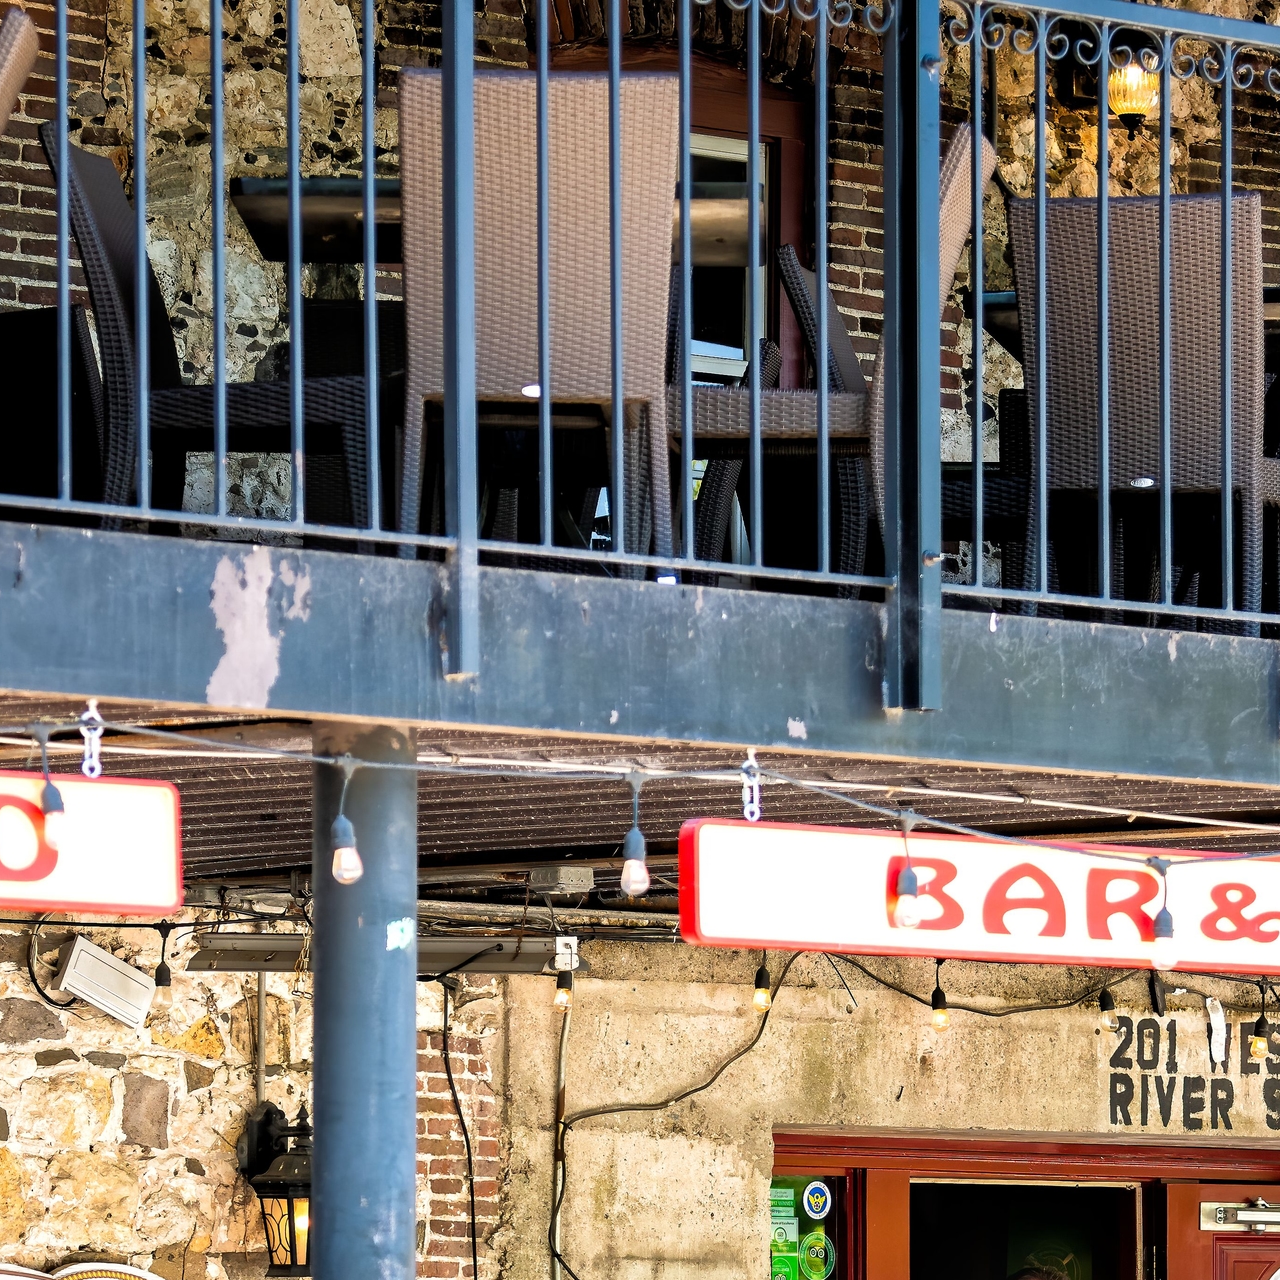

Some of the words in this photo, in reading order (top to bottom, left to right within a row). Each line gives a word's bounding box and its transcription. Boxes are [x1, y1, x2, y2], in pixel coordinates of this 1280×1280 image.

[886, 854, 1162, 942] BAR
[1109, 1016, 1177, 1073] 201
[1110, 1073, 1233, 1130] RIVER
